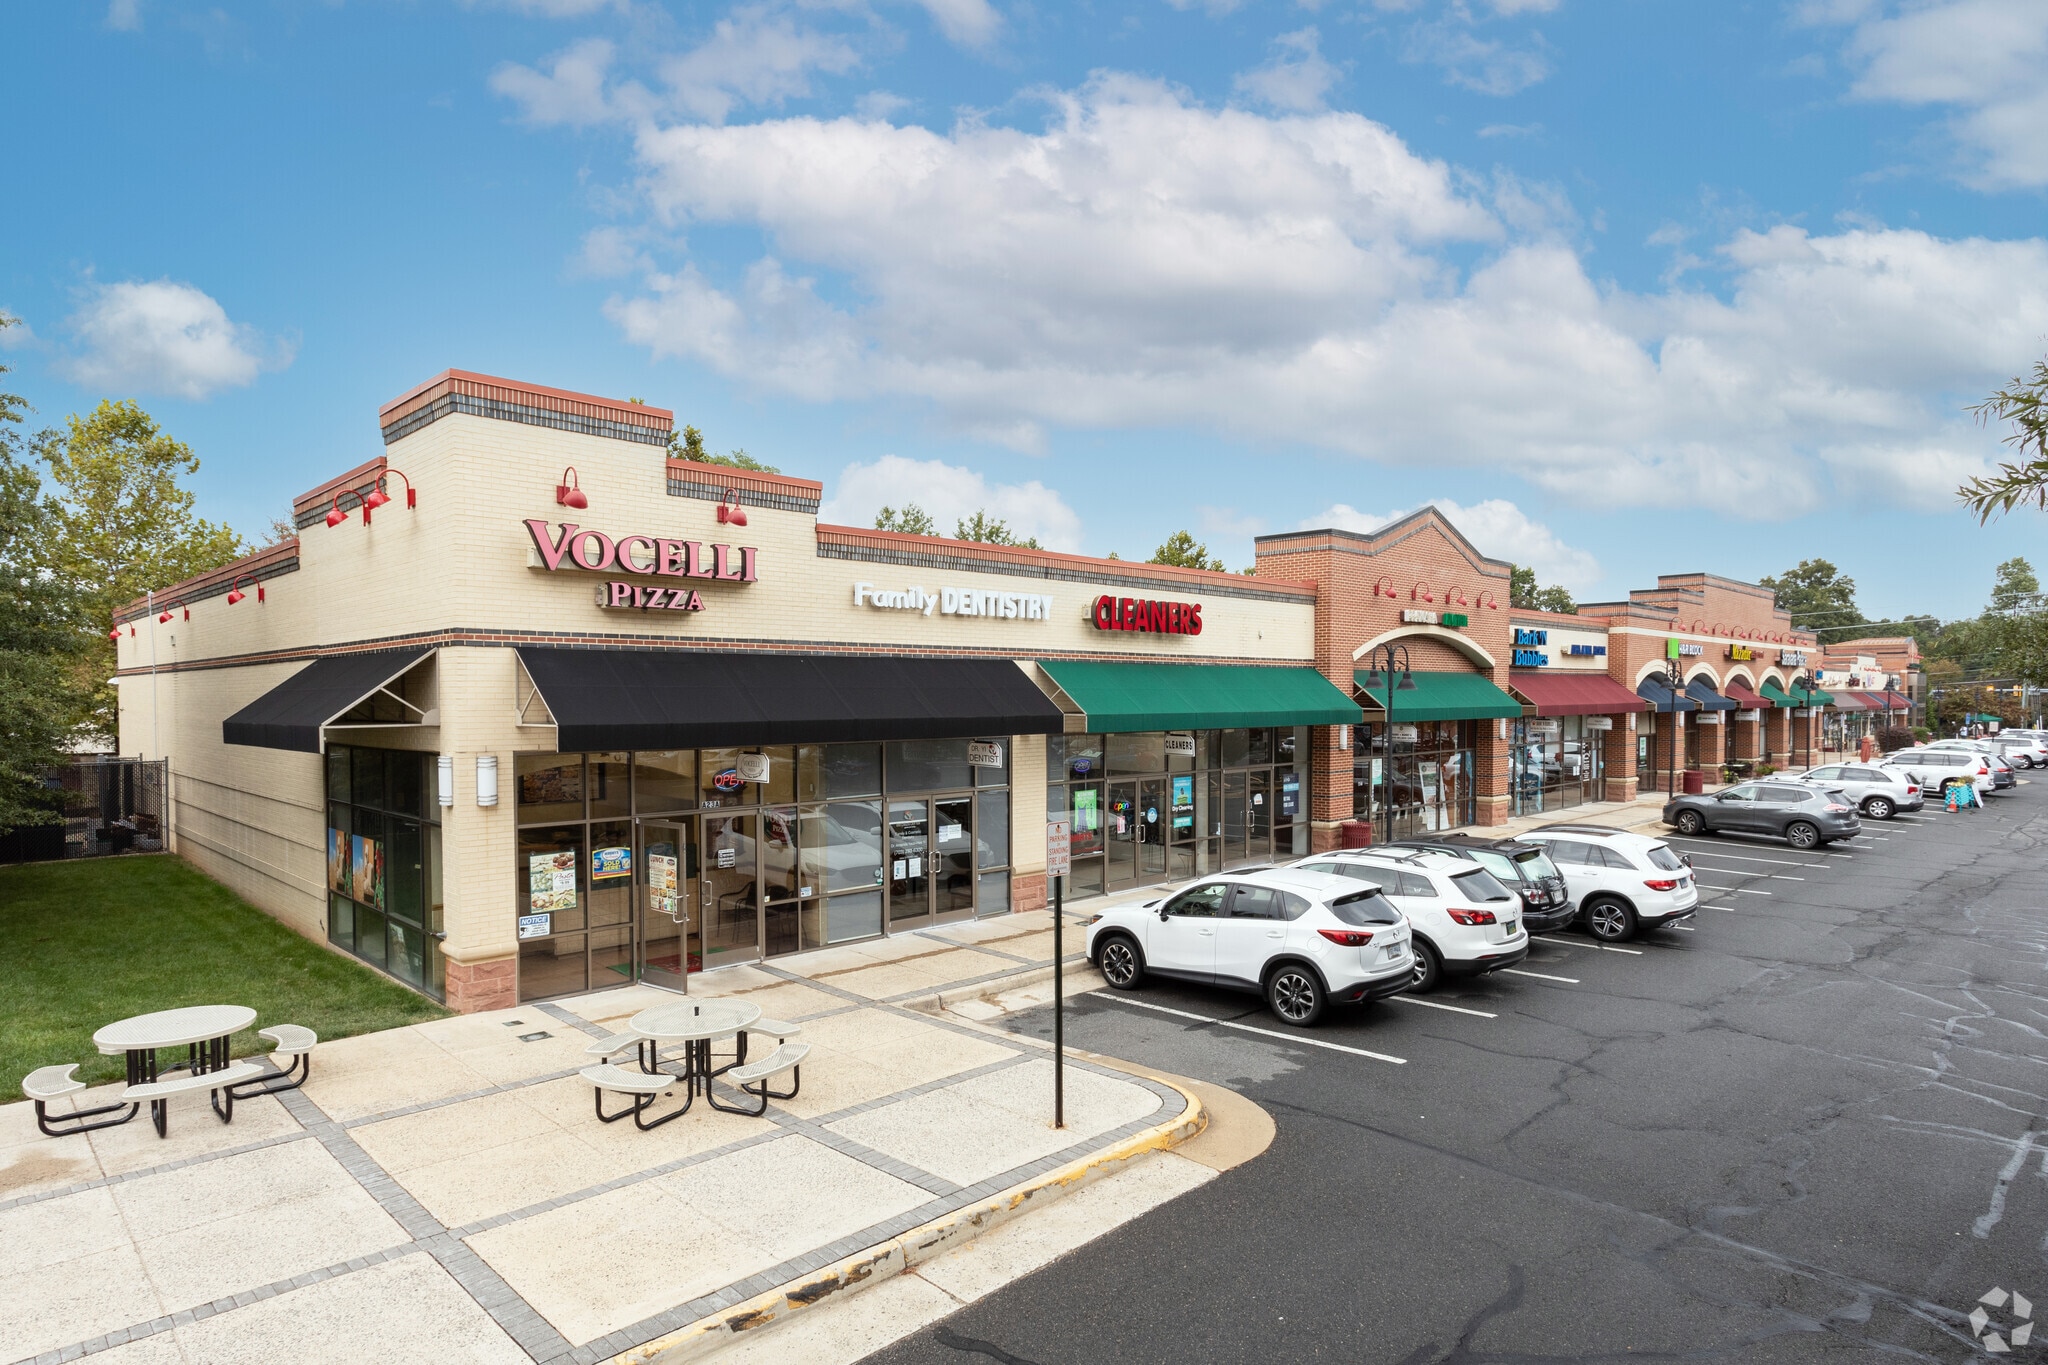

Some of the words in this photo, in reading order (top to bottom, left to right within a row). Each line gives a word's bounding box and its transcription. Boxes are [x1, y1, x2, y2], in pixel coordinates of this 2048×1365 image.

[523, 519, 758, 582] VOCELLI
[606, 581, 706, 611] PIZZA
[854, 582, 938, 616] Family
[941, 586, 1053, 620] DENTISTRY
[1091, 595, 1203, 636] CLEANERS
[1514, 629, 1538, 645] Bark
[1512, 649, 1548, 666] Bubbles
[1165, 740, 1193, 750] CLEANERS
[969, 753, 999, 762] DENTIST
[1114, 801, 1130, 811] open
[1179, 803, 1194, 811] Cleaning
[1049, 834, 1067, 842] PARKING
[1049, 846, 1068, 855] STANDING
[1049, 857, 1057, 866] FIRE
[1059, 855, 1068, 864] LANE
[603, 864, 621, 872] HERE!
[521, 916, 547, 925] NOTICE
